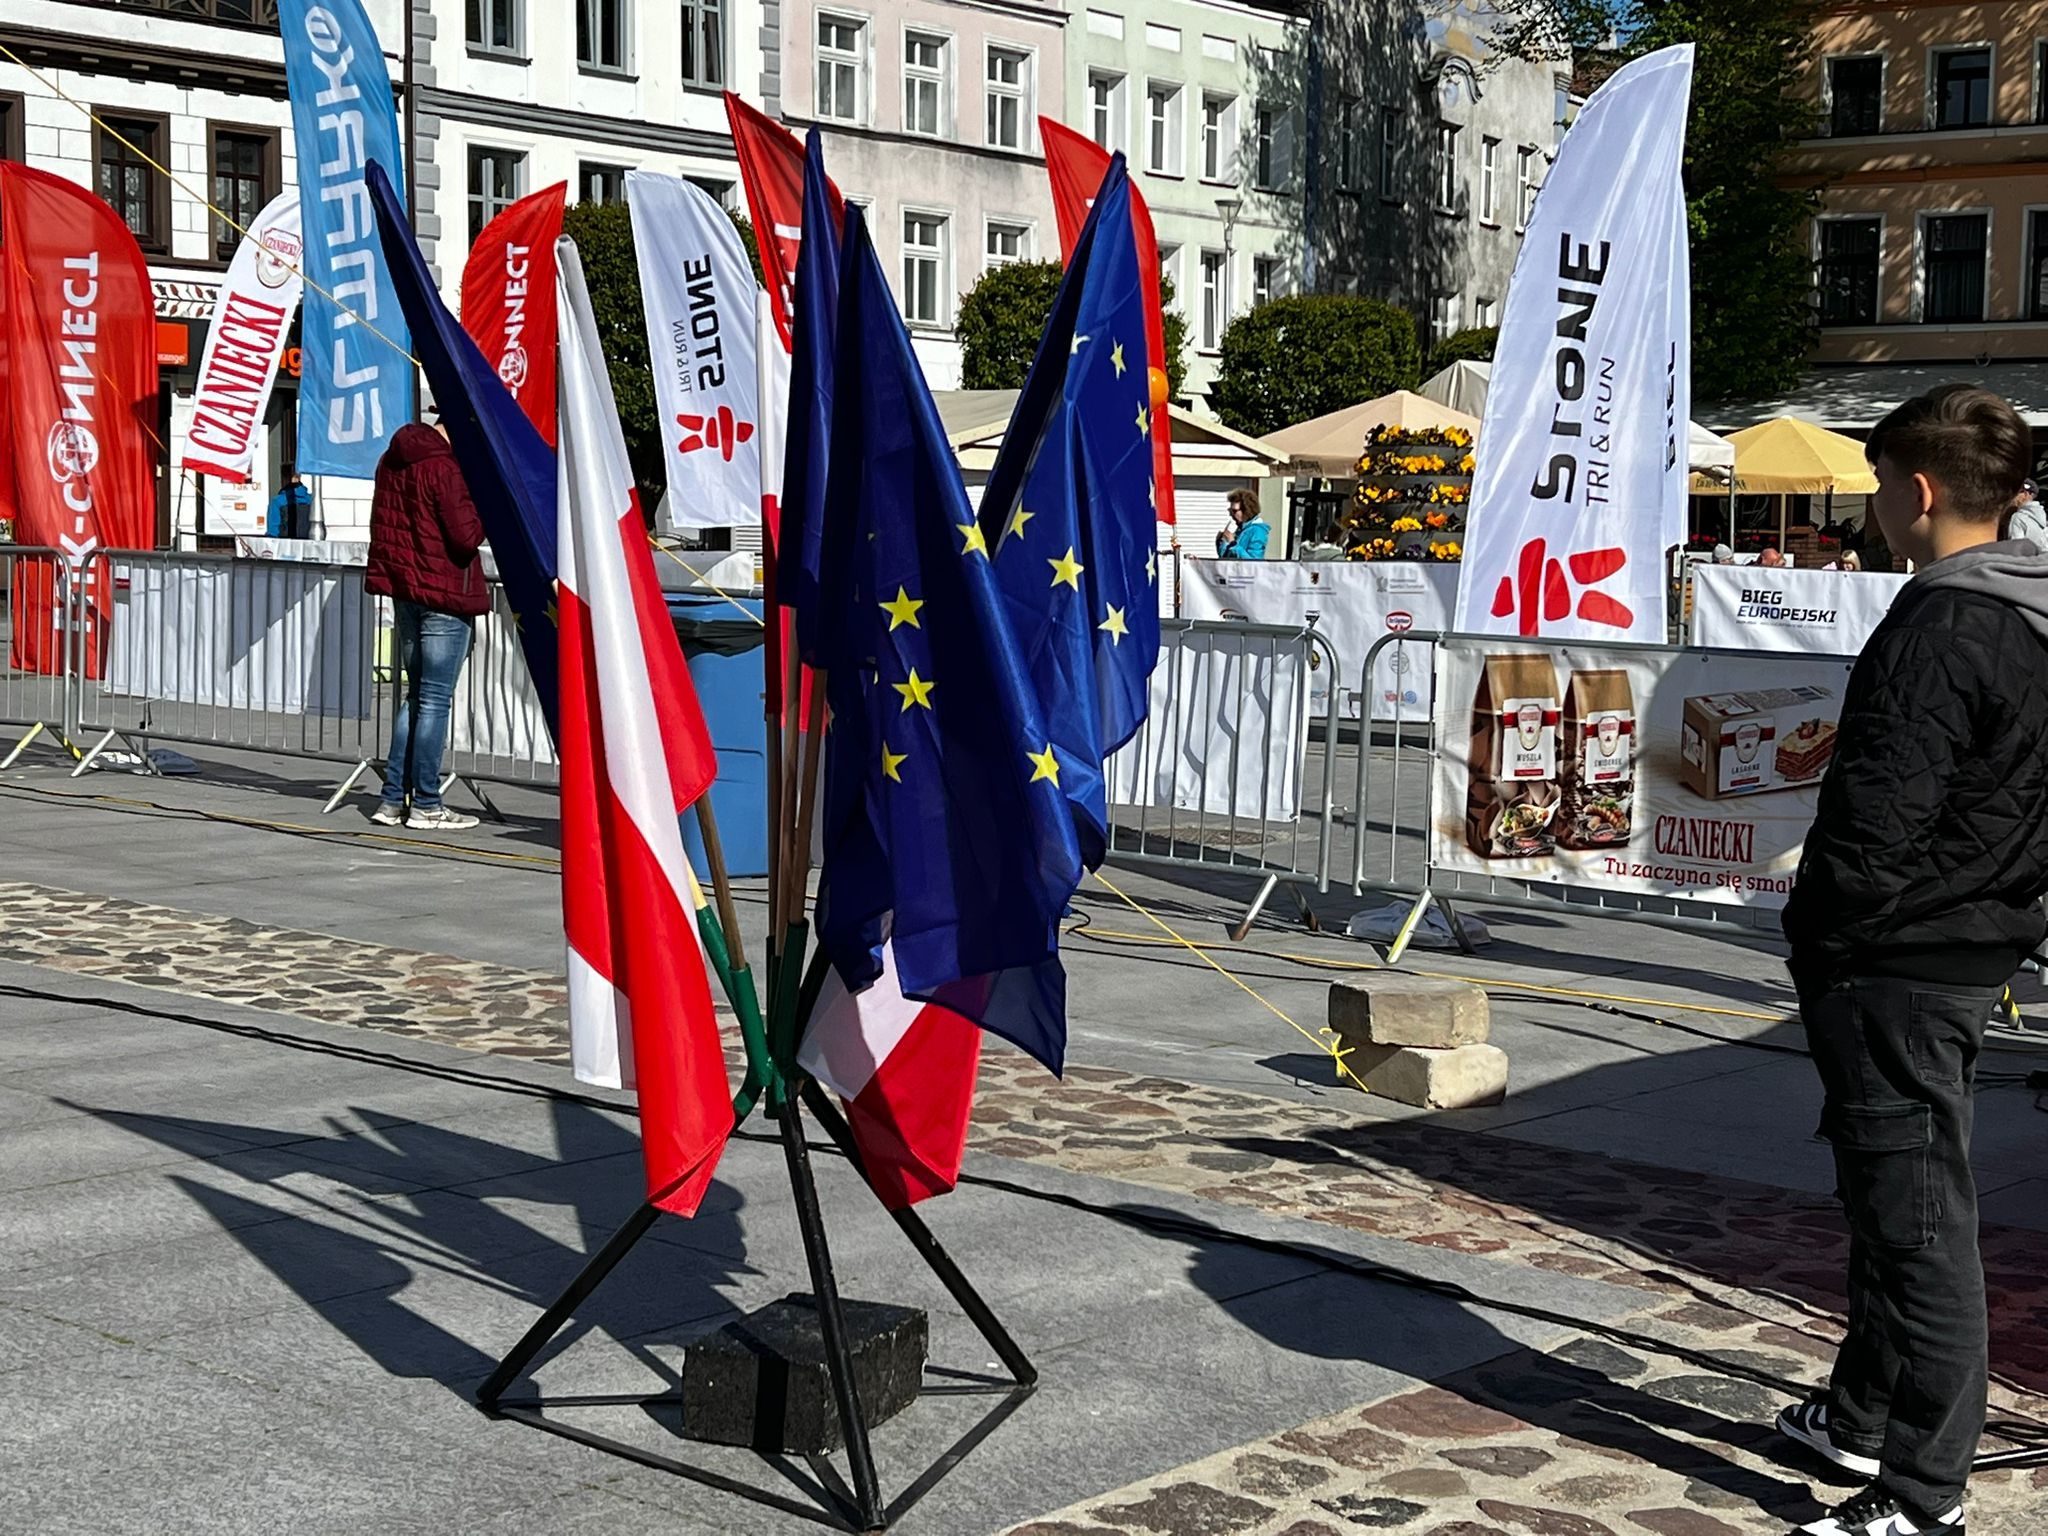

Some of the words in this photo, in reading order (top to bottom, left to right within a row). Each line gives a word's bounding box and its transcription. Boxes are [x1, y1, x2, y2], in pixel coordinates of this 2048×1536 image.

[188, 290, 287, 456] CZANIECKI
[1530, 232, 1611, 504] STONE
[1593, 357, 1615, 425] RUN
[1589, 434, 1609, 453] &
[1586, 460, 1609, 507] TRI
[1737, 605, 1837, 623] EUROPEJSKI
[1741, 589, 1783, 605] BIEG
[1655, 814, 1756, 864] CZANIECKI
[1604, 857, 1627, 876] Tu
[1631, 863, 1710, 887] zaczyna
[1715, 870, 1742, 893] się
